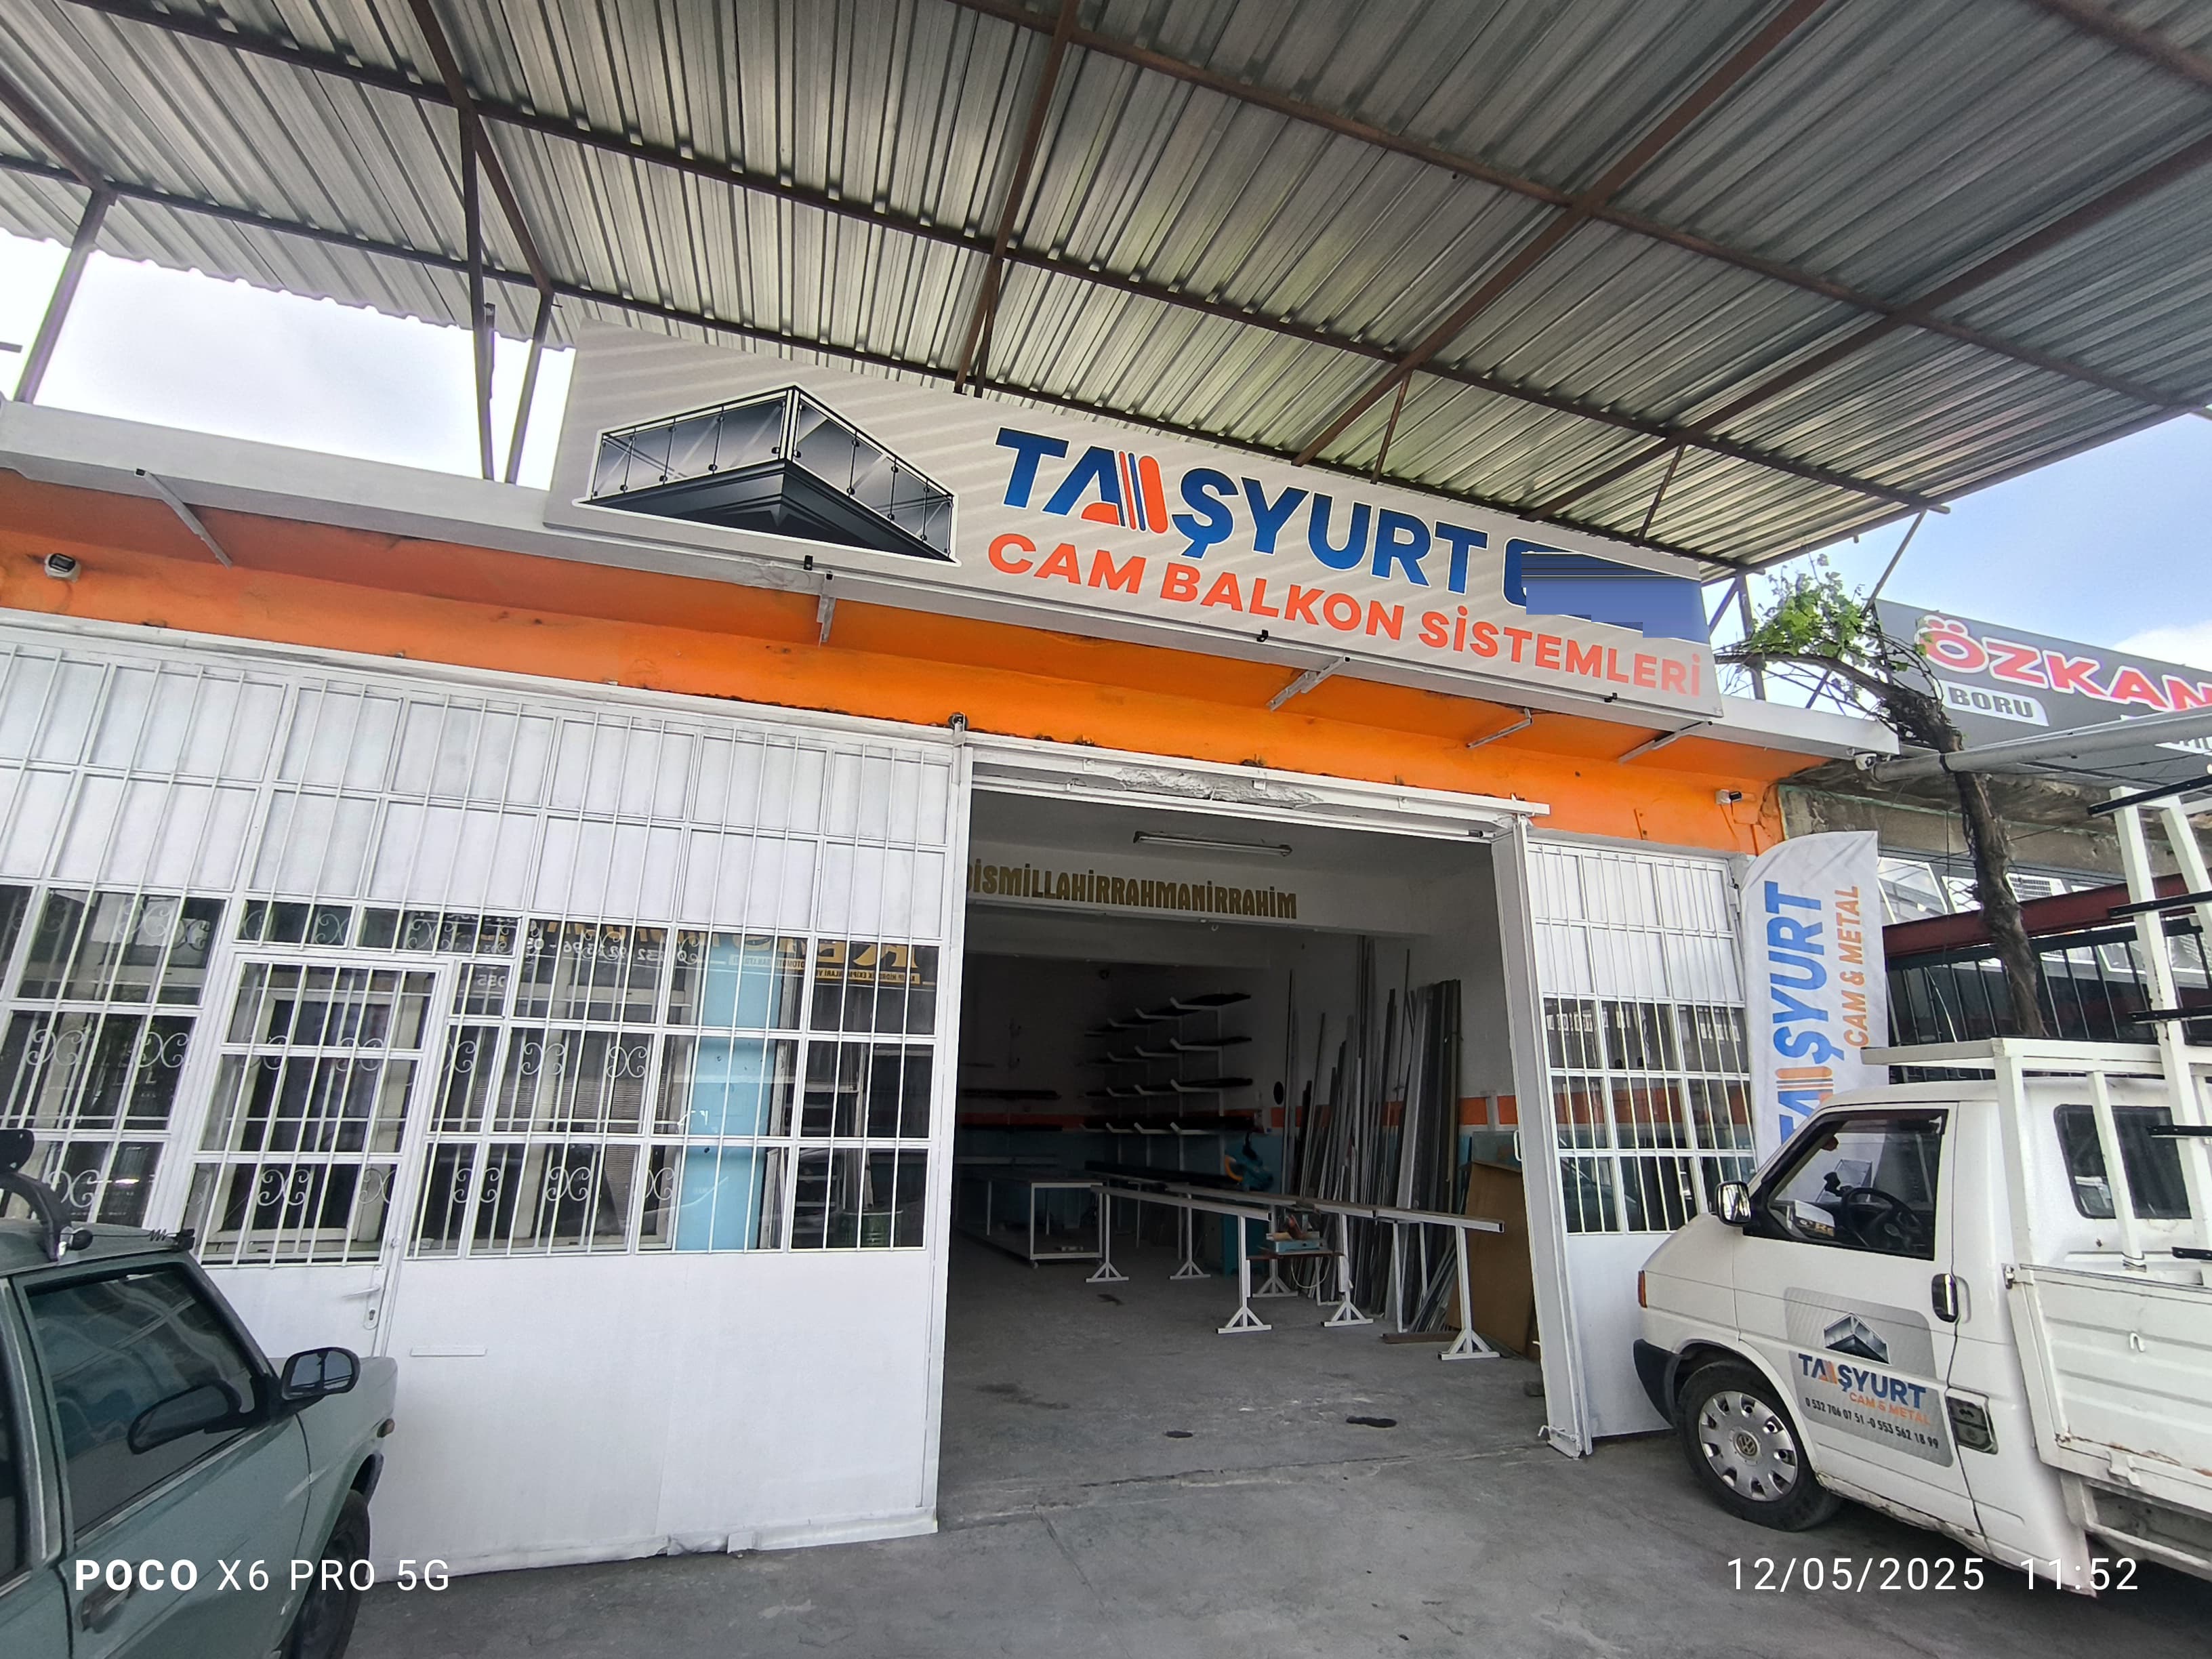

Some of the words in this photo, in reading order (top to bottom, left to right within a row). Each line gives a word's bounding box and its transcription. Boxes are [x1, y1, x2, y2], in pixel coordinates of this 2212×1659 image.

[996, 427, 1488, 595] TAŞYURT
[987, 532, 1145, 594] CAM
[1160, 562, 1403, 642] BALKON
[1418, 605, 1701, 698] SİSTEMLERİ
[1948, 686, 2034, 719] BORU
[1835, 886, 1864, 964] METAL
[1840, 970, 1865, 987] &
[1843, 990, 1870, 1048] CAM
[1805, 1397, 1810, 1407] 0
[1811, 1399, 1826, 1412] 532
[1827, 1404, 1841, 1416] 706
[1843, 1409, 1851, 1420] 07
[1854, 1412, 1864, 1424] 51
[1877, 1420, 1893, 1433] 553
[1895, 1426, 1912, 1440] 562
[1914, 1433, 1925, 1444] 18
[1927, 1437, 1939, 1448] 99
[1849, 1392, 1876, 1409] CAM
[1889, 1403, 1931, 1425] METAL
